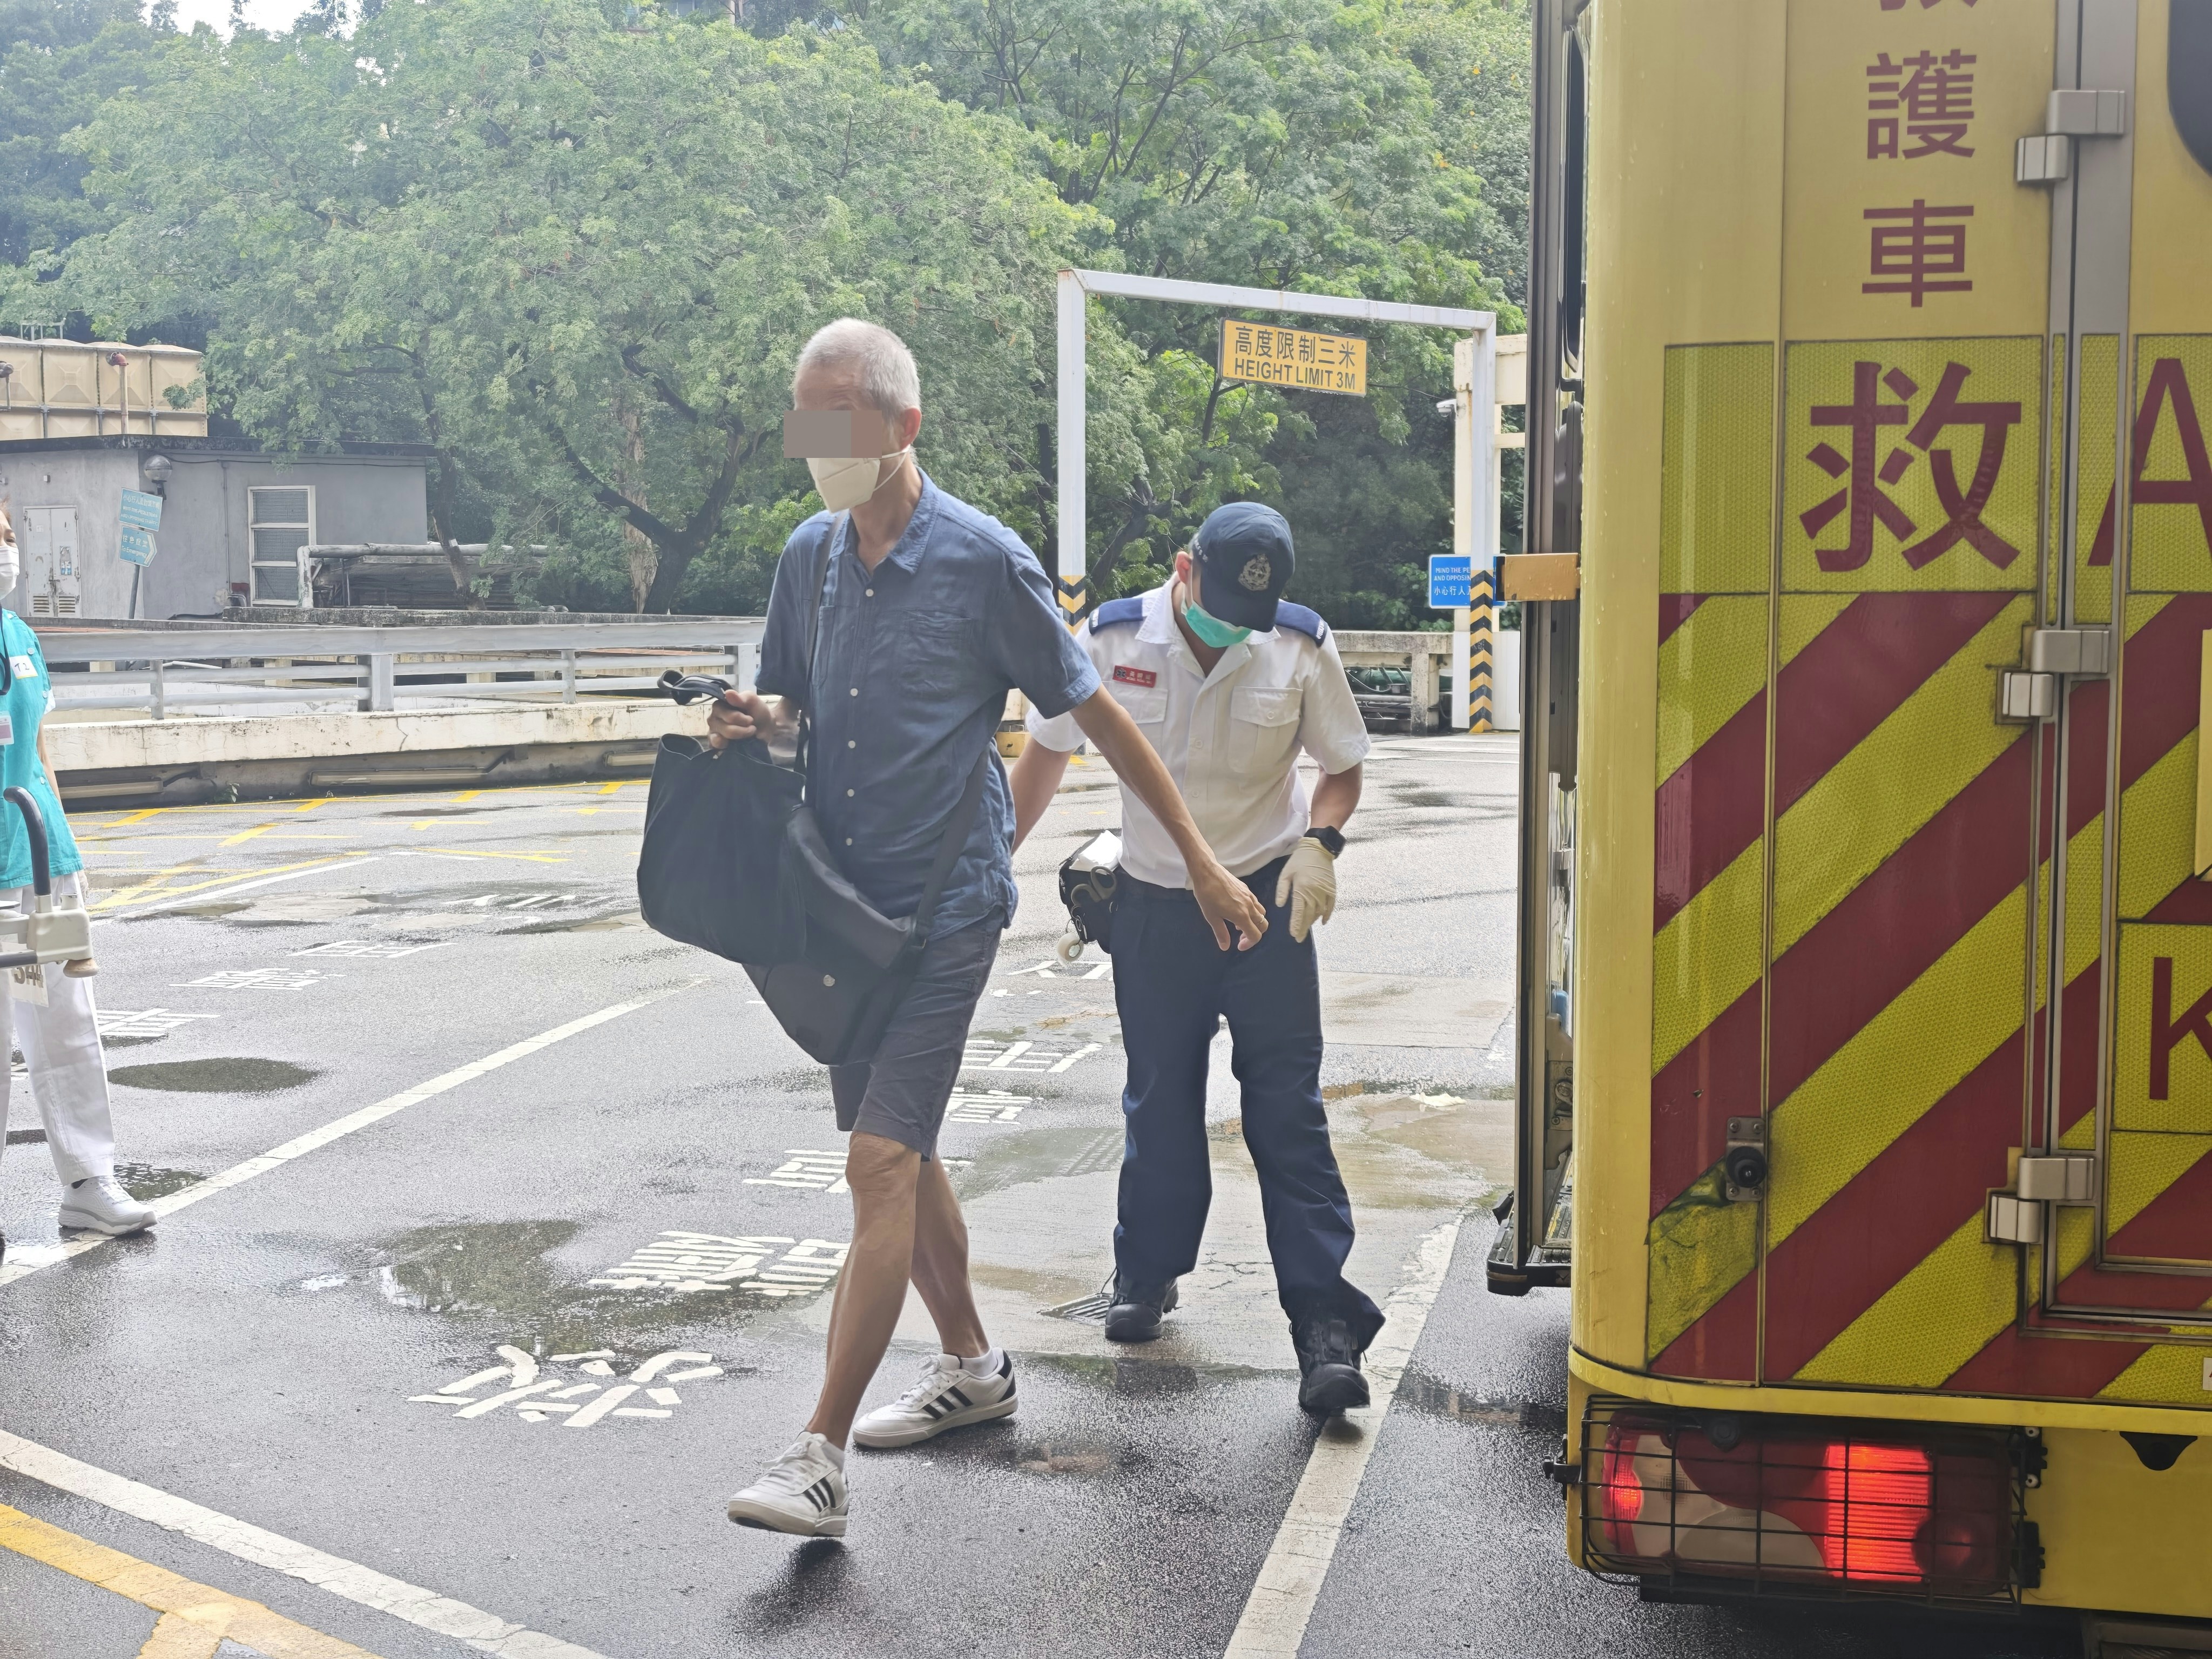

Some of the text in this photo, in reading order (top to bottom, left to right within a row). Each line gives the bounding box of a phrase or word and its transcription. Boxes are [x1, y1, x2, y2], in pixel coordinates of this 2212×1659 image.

[1862, 0, 1977, 307] 護車
[1235, 326, 1356, 369] 高度限制三米
[1235, 358, 1355, 390] HEIGHT LIMIT 3M
[1799, 361, 2022, 572] 救
[1434, 585, 1471, 596] 小心行人
